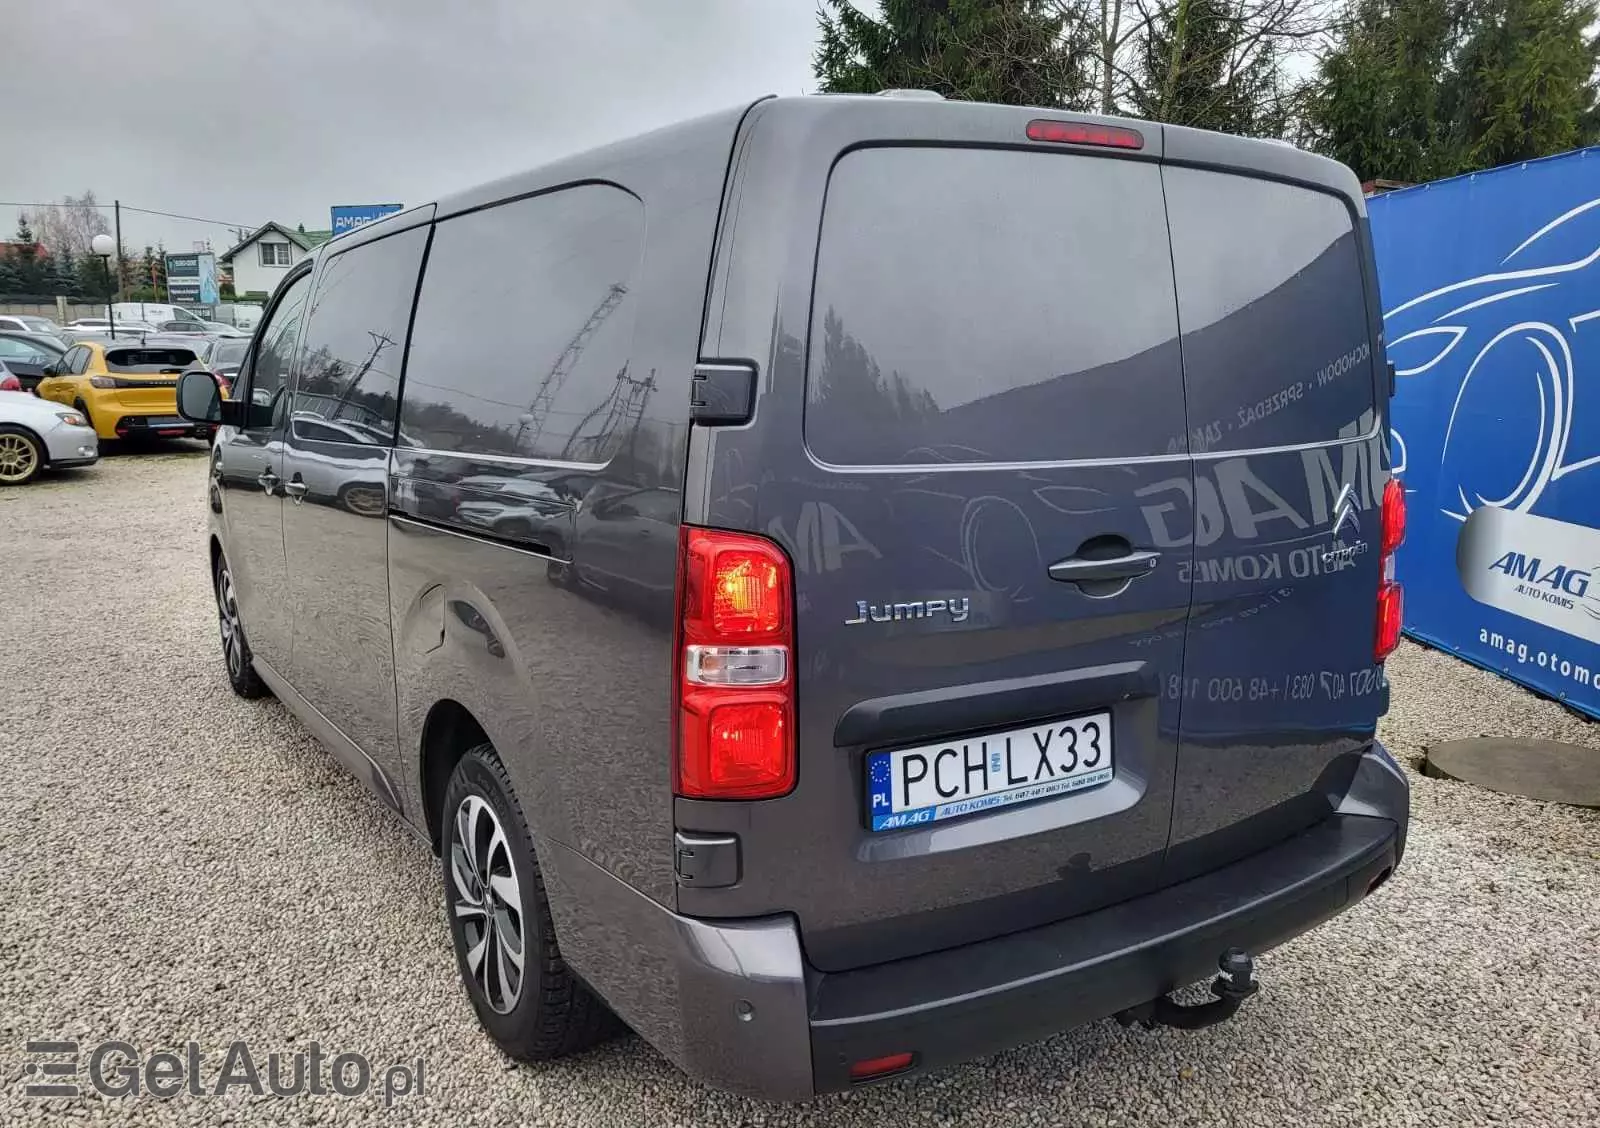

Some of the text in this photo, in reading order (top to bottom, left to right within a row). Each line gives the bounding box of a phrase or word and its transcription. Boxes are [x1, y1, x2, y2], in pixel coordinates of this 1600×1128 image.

[1488, 551, 1592, 598] AMAG
[1514, 584, 1575, 610] AUTO KOMIS
[902, 721, 1102, 807] PCH LX33
[872, 793, 890, 807] PL
[879, 811, 931, 829] AMAG
[941, 799, 967, 817] AUTO
